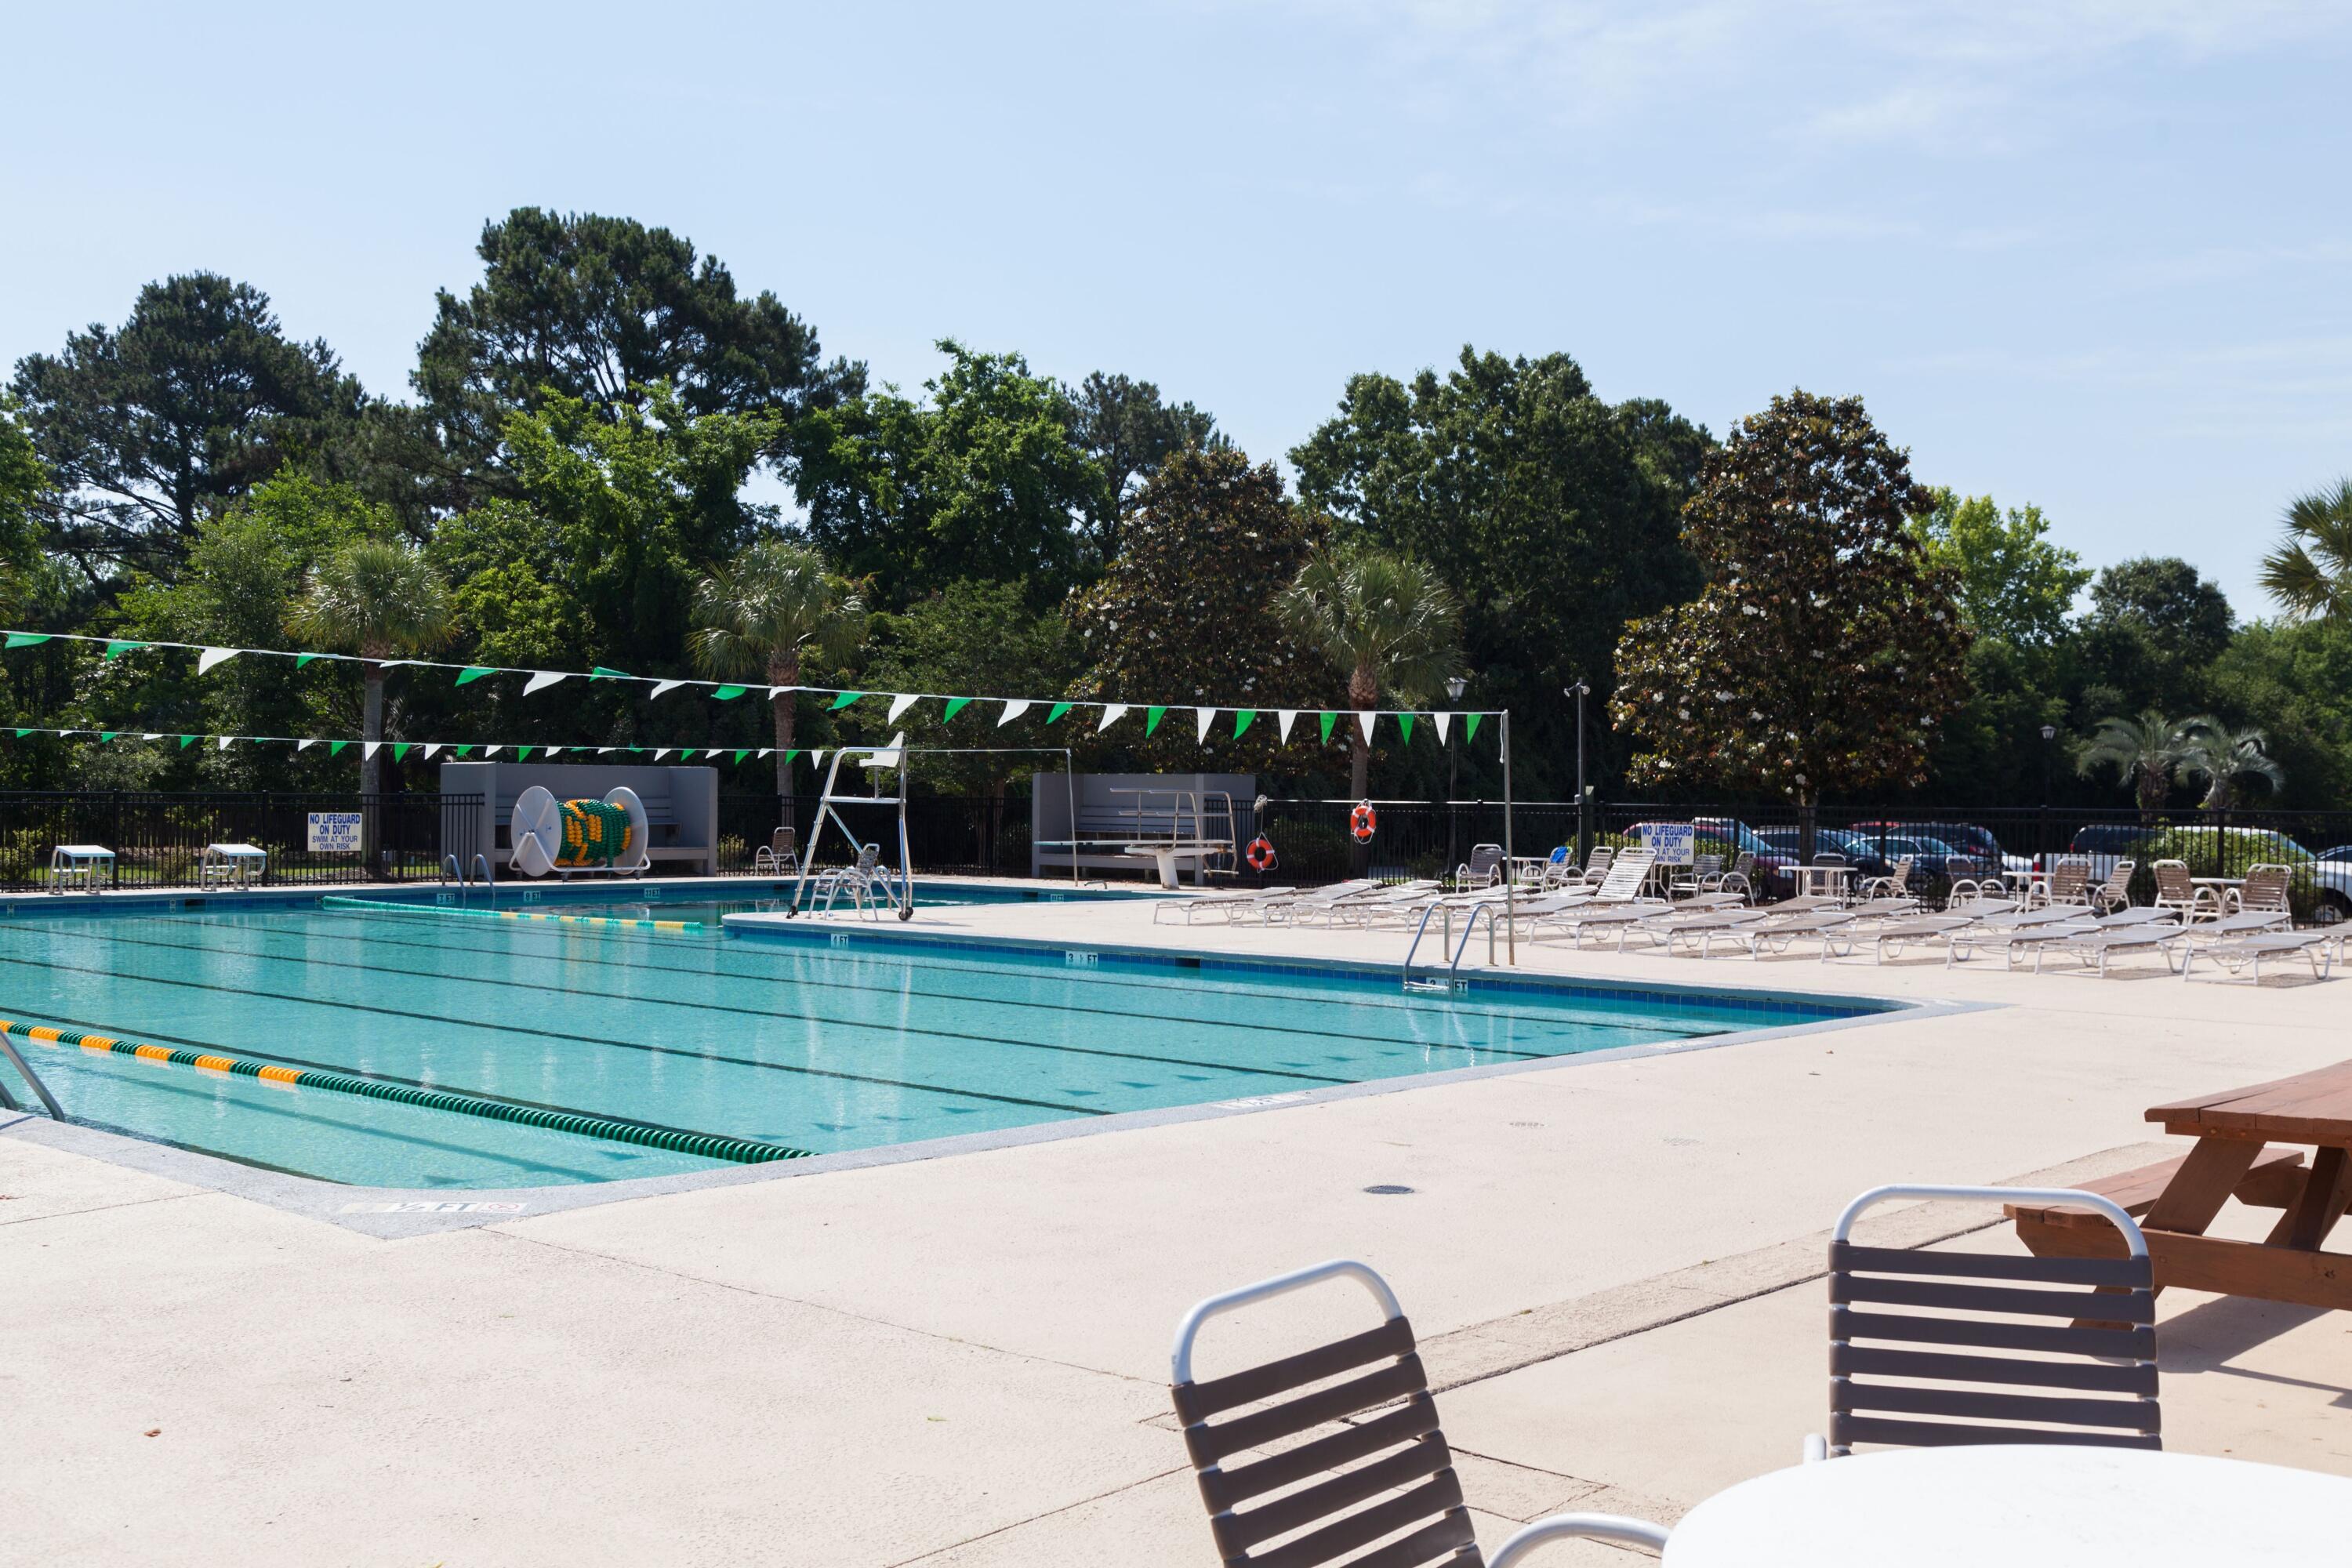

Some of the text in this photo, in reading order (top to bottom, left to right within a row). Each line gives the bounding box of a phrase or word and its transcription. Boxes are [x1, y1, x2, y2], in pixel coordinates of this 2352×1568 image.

[310, 814, 361, 824] NO LIFEGUARD
[319, 825, 350, 835] ON DUTY
[1642, 825, 1693, 837] NO LIFEGUARD
[1651, 837, 1682, 848] ON DUTY
[840, 935, 848, 946] FT
[1087, 954, 1098, 964] FT
[1454, 982, 1467, 993] FT
[434, 1203, 477, 1211] FT
